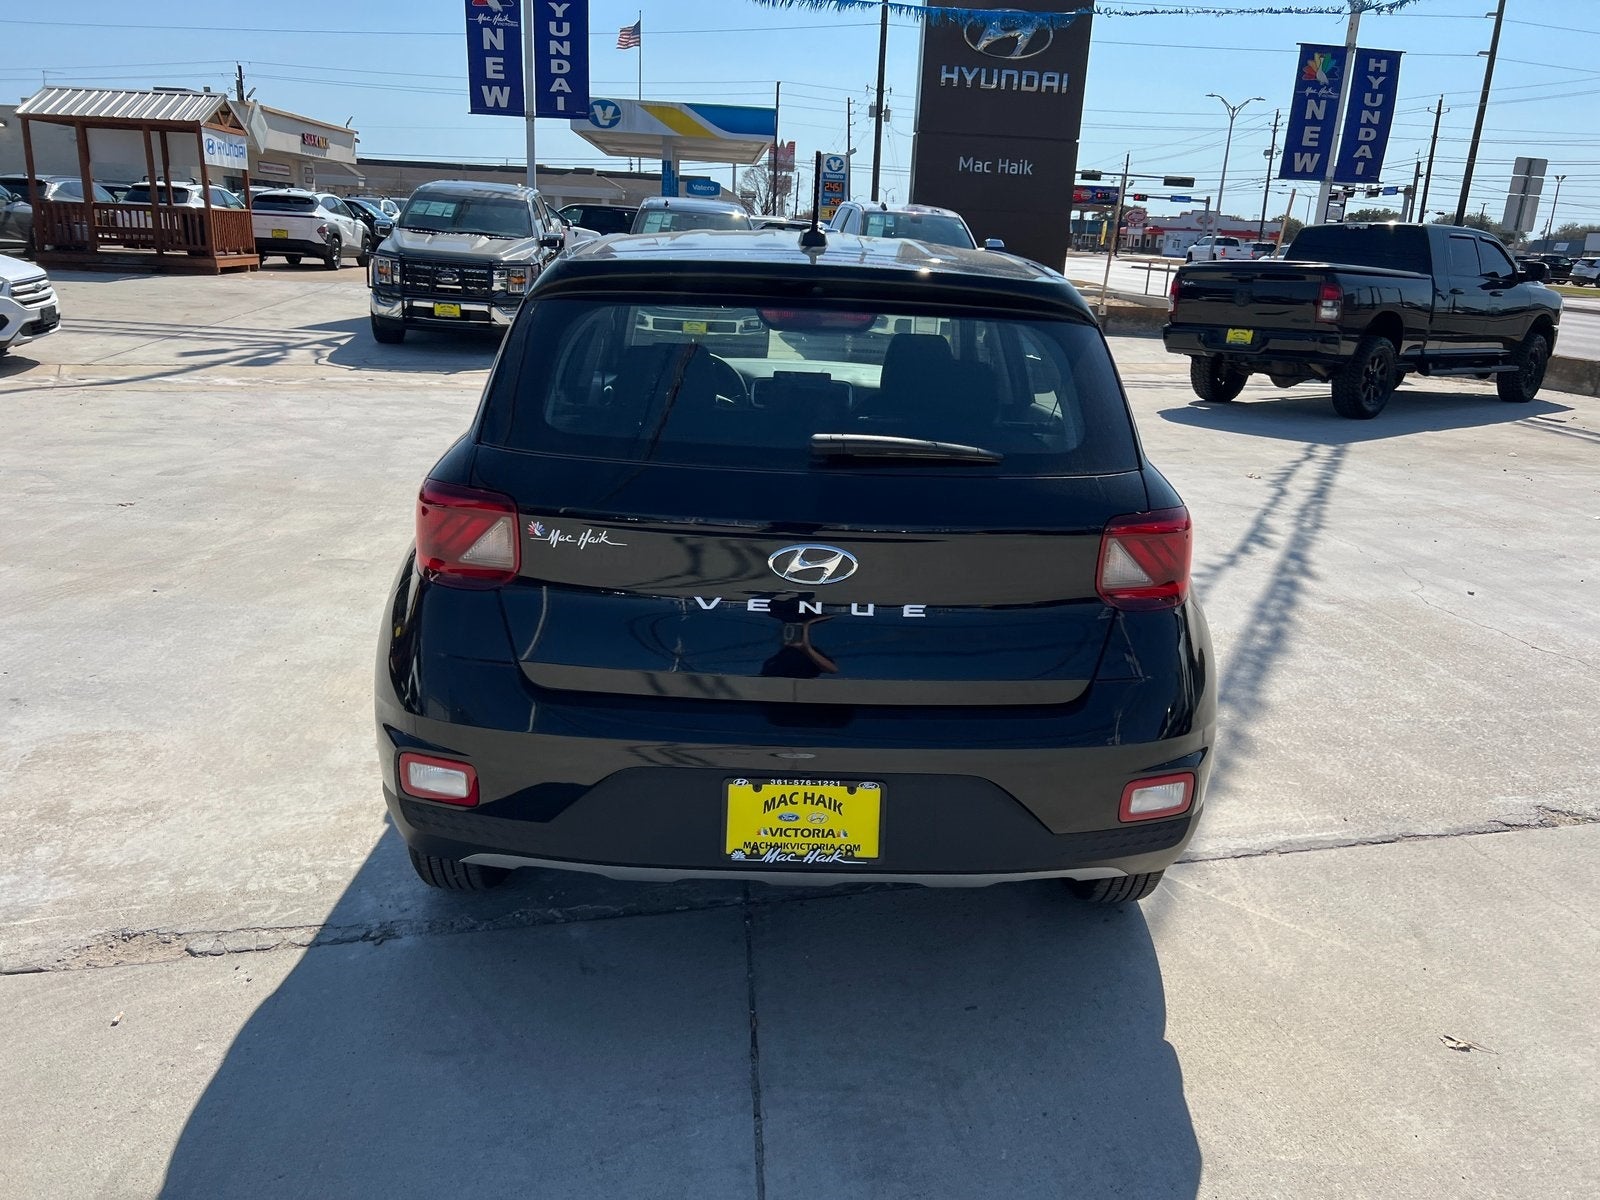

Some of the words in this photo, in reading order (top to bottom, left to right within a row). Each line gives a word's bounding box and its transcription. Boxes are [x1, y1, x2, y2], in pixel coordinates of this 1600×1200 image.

[481, 28, 511, 108] NEW
[940, 64, 1069, 94] HYUNDAI
[1353, 58, 1388, 175] HYUNDAI
[1294, 100, 1327, 173] NEW
[216, 141, 246, 160] HYUNDAI
[958, 156, 992, 173] Mac
[997, 158, 1033, 175] Haik
[692, 184, 715, 192] Valero
[545, 529, 577, 548] Mac
[577, 529, 619, 549] Haik
[694, 596, 927, 618] VENUE
[770, 779, 841, 787] 361-576-1221
[763, 792, 799, 814] MAC
[803, 792, 843, 816] HAIK
[768, 827, 836, 839] VICTORIA
[759, 847, 801, 863] Mac
[802, 847, 850, 864] Haik
